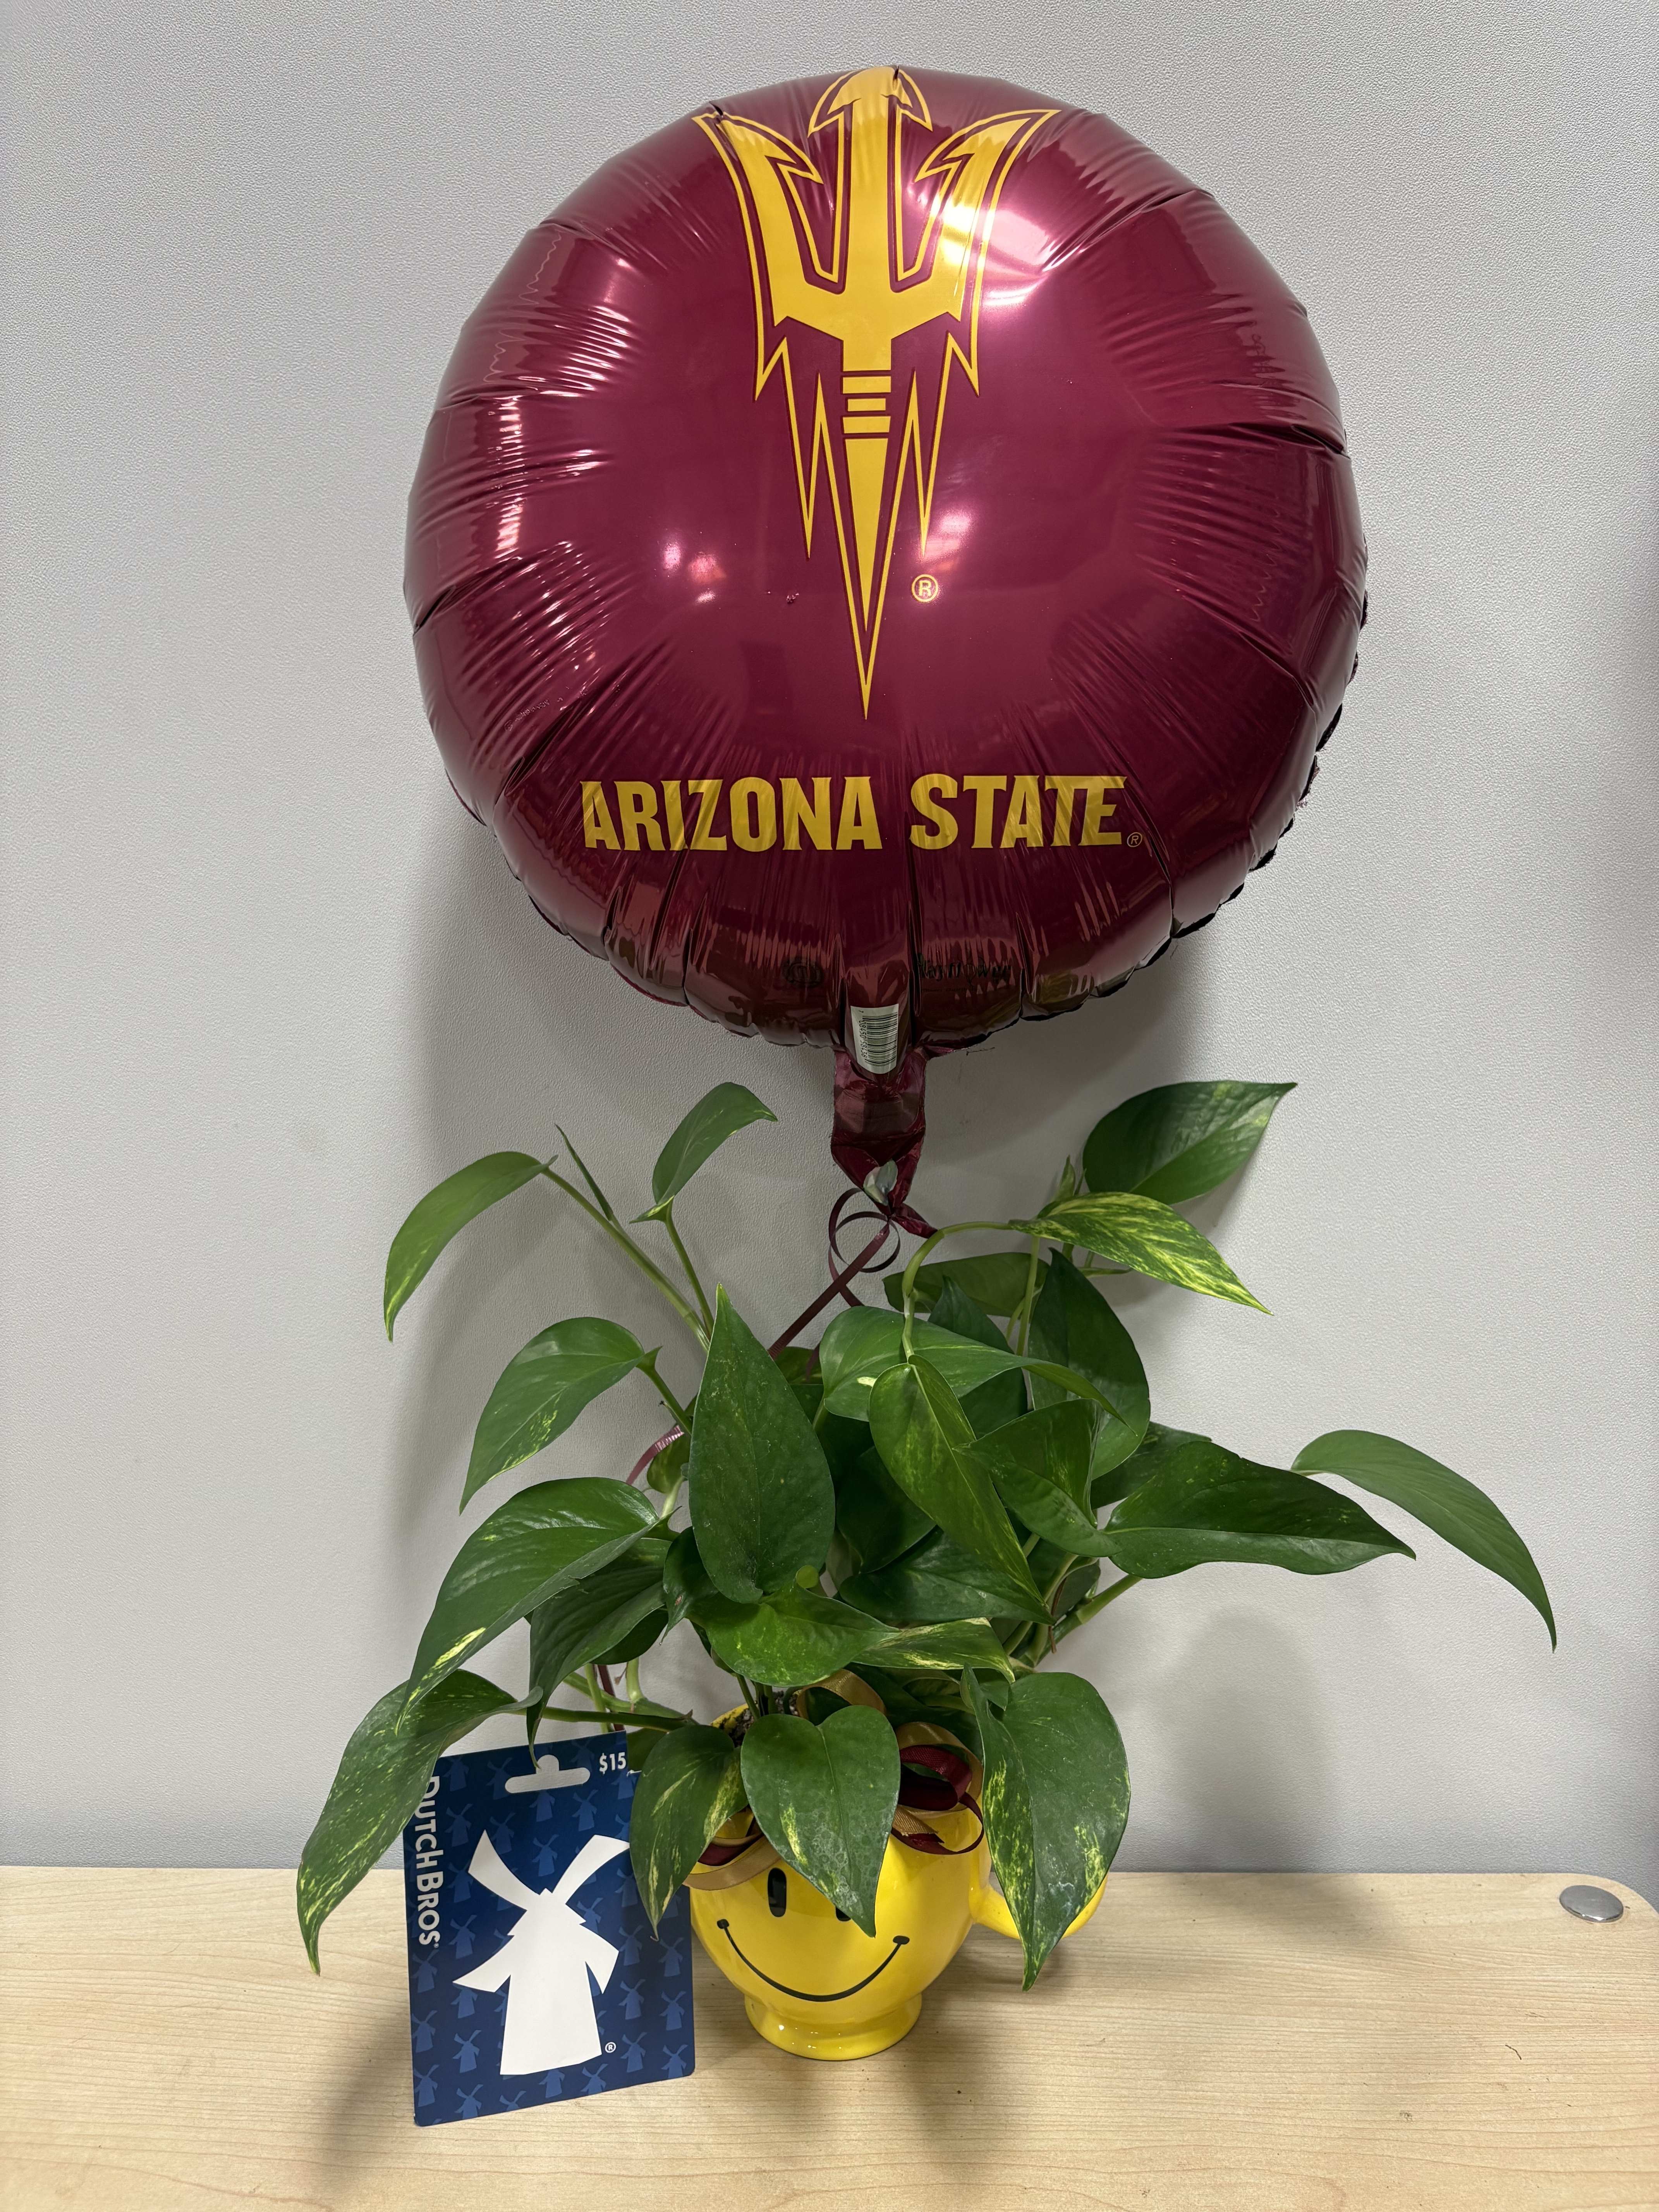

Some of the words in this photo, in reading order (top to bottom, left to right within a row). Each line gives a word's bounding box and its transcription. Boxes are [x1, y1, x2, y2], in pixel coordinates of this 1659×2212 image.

[580, 776, 882, 852] ARIZONA
[859, 1020, 867, 1039] 08450
[599, 1752, 626, 1774] $15
[414, 1776, 444, 1869] DUTCH
